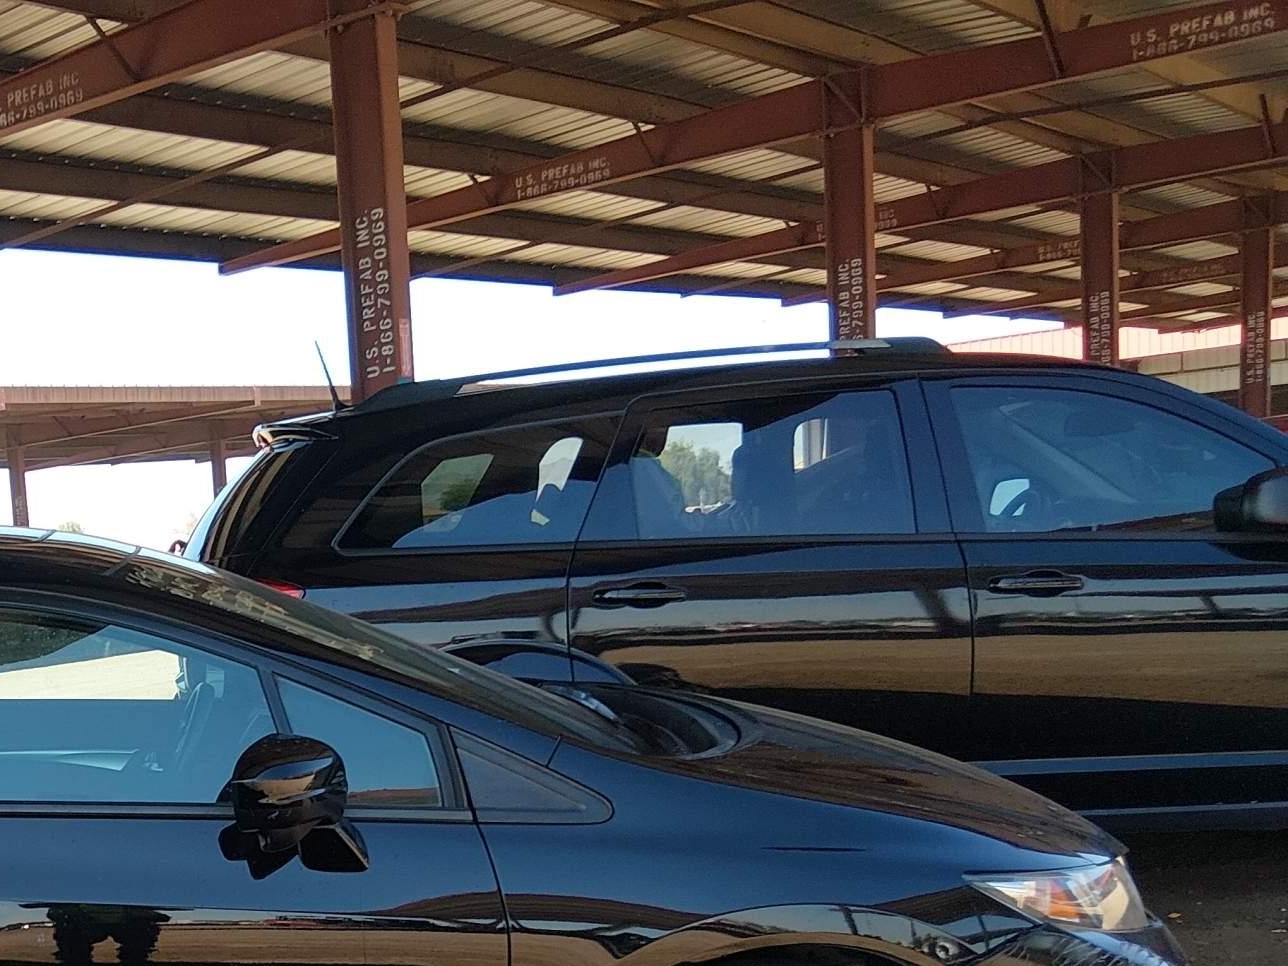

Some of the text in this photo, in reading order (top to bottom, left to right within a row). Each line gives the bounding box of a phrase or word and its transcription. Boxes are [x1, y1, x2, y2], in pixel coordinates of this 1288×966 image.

[1169, 10, 1235, 38] PREFAB
[7, 79, 54, 108] PREFAB
[541, 161, 585, 181] PREFAB
[355, 209, 381, 379] U.S. PREFAB INC.
[370, 207, 396, 373] 1-866-799-0969
